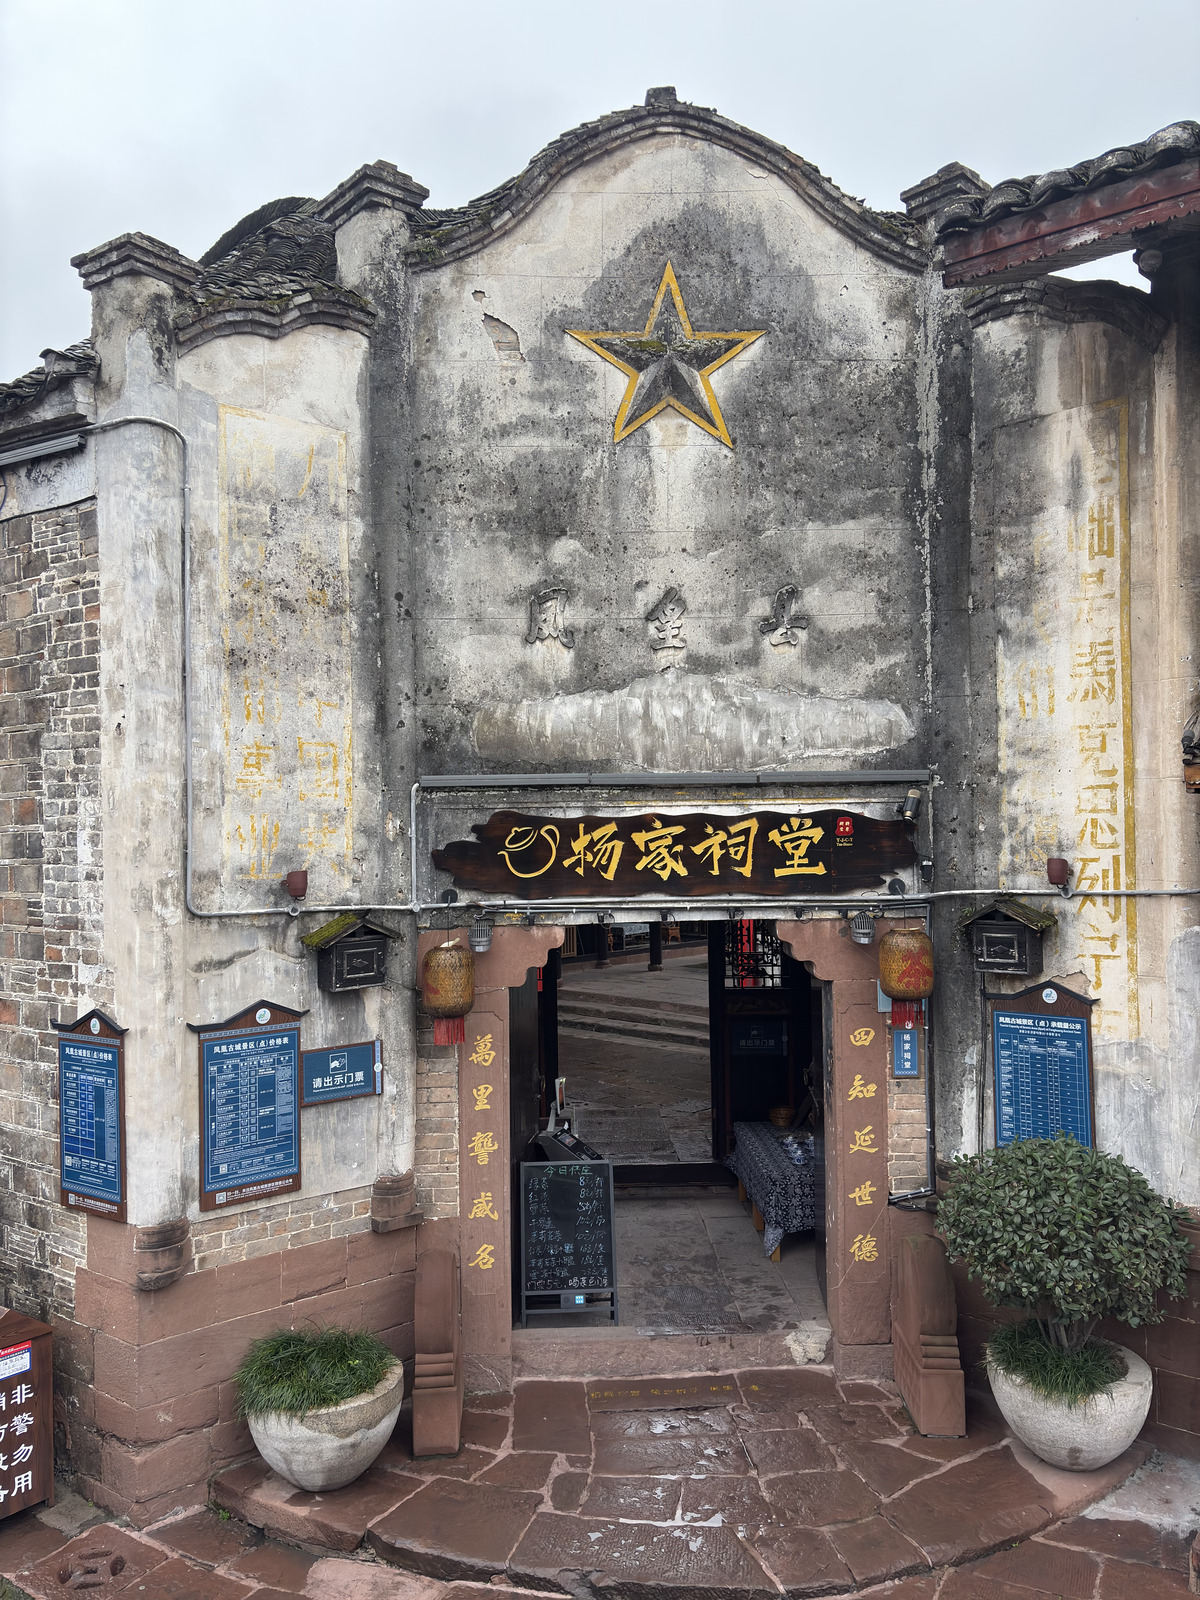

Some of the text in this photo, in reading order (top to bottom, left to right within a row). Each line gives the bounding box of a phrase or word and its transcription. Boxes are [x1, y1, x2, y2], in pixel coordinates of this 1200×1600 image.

[563, 817, 827, 881] 杨家祠堂
[312, 1070, 365, 1089] 请出示门票
[848, 1027, 879, 1262] 四知延世德
[10, 1383, 34, 1497] 非警勿用
